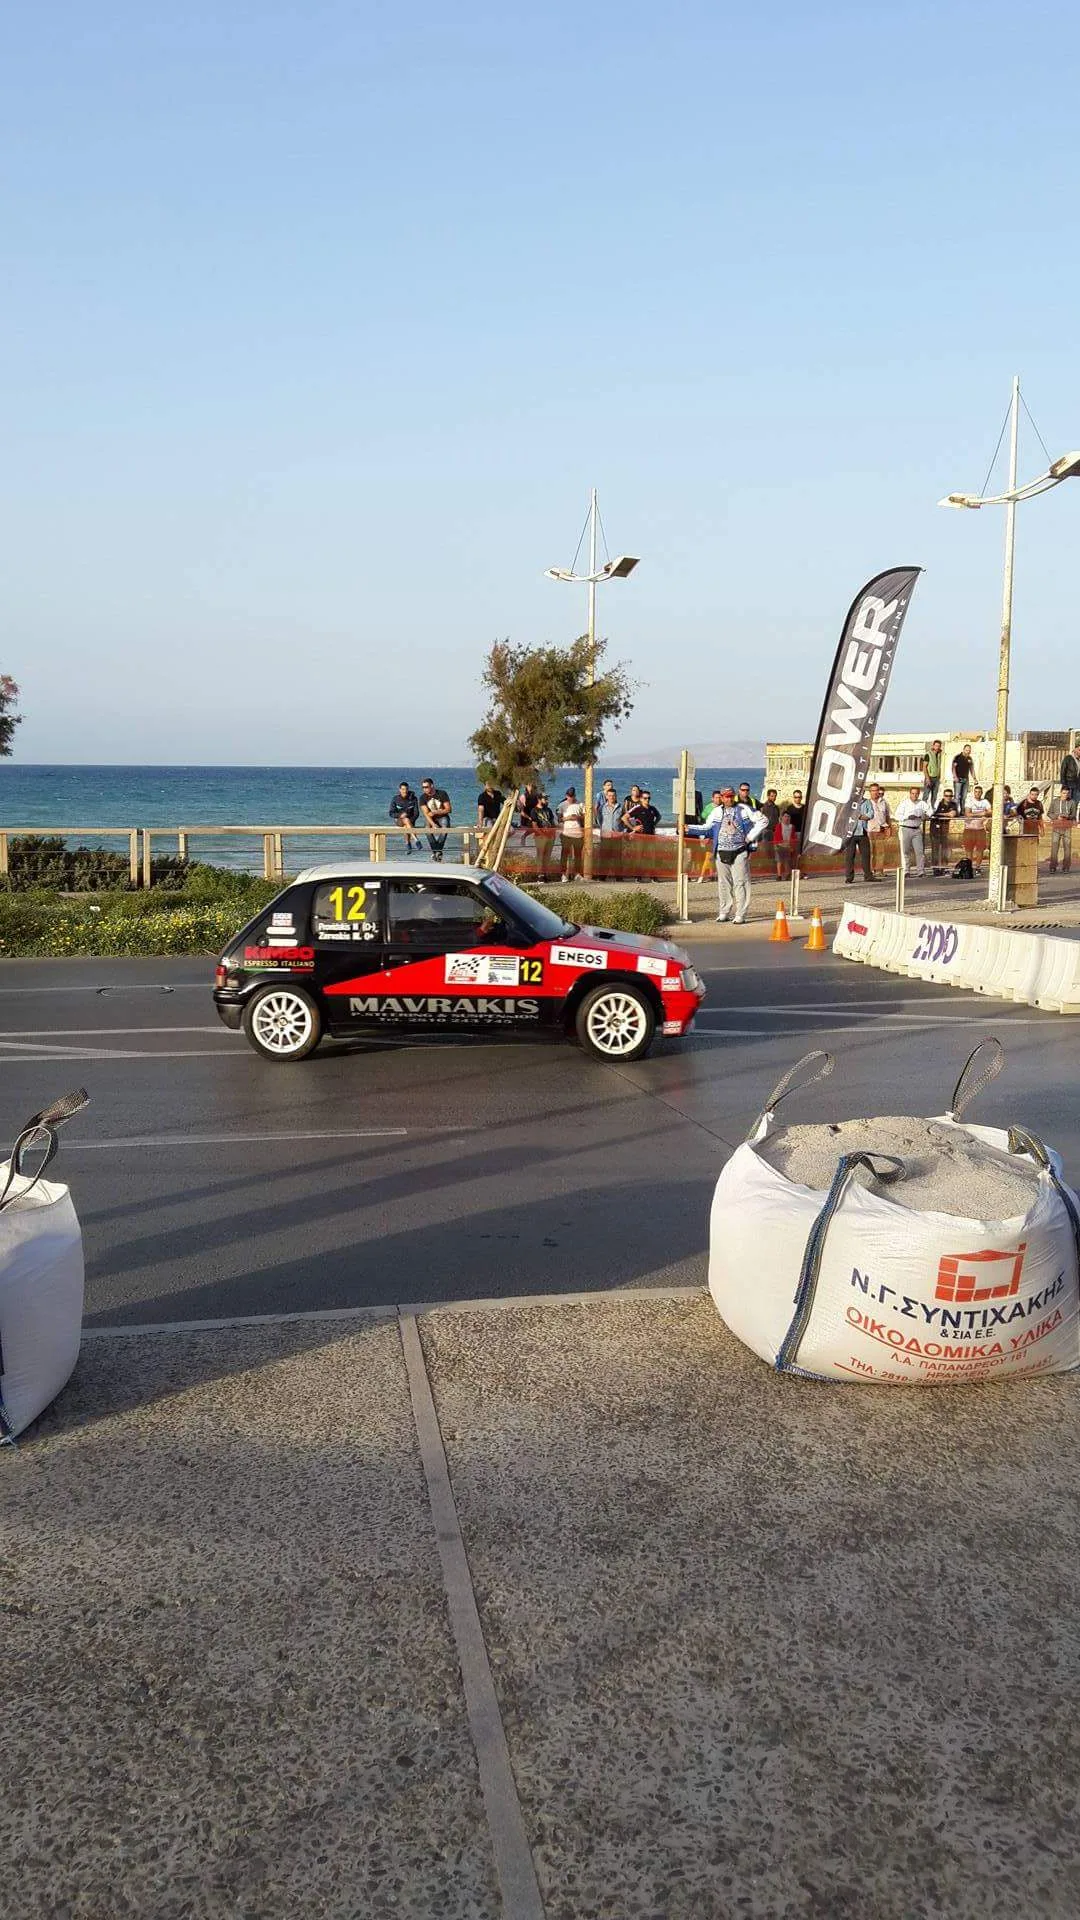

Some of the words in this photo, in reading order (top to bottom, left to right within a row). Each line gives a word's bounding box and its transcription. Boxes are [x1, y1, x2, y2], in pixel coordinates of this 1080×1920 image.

[809, 596, 898, 850] POWER
[847, 717, 876, 839] UTOMOTIVE
[875, 598, 906, 701] MAGAZINE
[329, 886, 366, 921] 12
[281, 960, 315, 968] ITALIANO
[558, 951, 603, 965] ENEOS
[520, 960, 542, 982] 12
[349, 997, 540, 1014] MAVRAKIS
[846, 1307, 1003, 1358] ΟΙΚΟΔΟΜΙΚΑ
[1010, 1310, 1062, 1349] ΥΛΙΚΑ
[940, 1329, 949, 1338] &
[952, 1330, 971, 1340] ΣΙΑ
[975, 1328, 996, 1339] Ε.Ε.
[850, 1357, 877, 1375] ΤΗΛ:
[919, 1355, 1008, 1371] ΠΑΠΑΝΔΡΕΟΥ
[926, 1369, 990, 1379] ΗΡΑΚΛΕΙΟ
